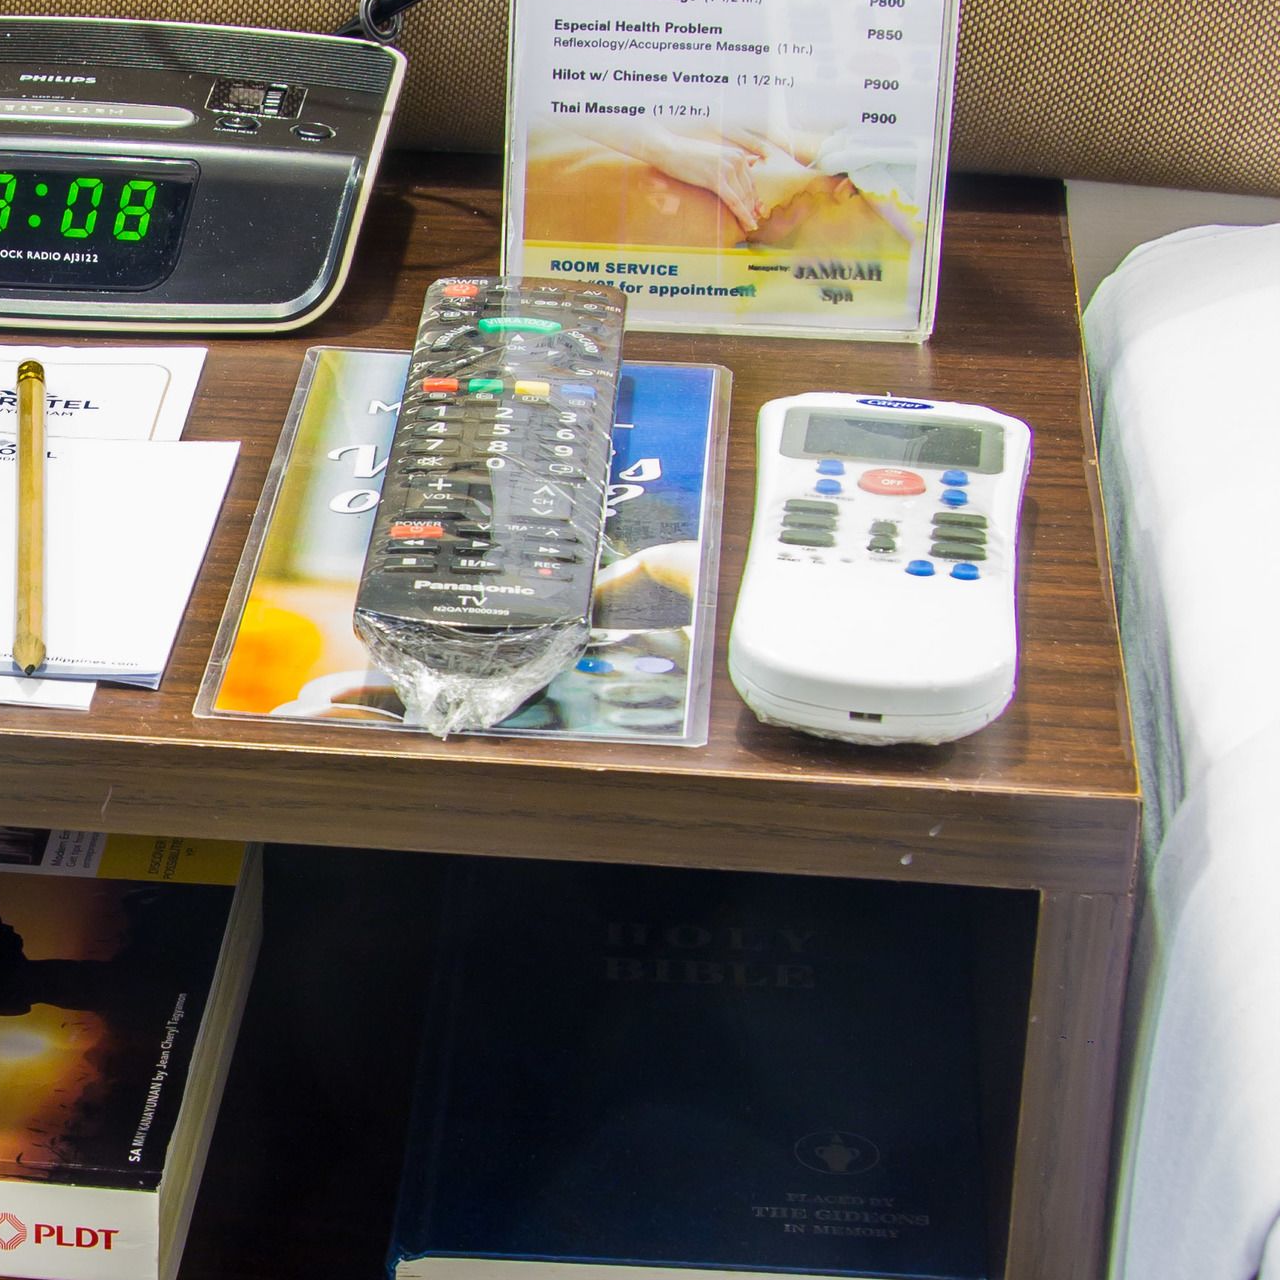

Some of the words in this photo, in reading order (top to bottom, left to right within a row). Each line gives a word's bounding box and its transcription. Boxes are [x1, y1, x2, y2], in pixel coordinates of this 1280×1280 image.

[554, 18, 611, 34] Especial
[615, 20, 660, 33] Health
[664, 21, 723, 35] Problem
[867, 28, 903, 41] P850
[553, 36, 712, 52] Reflexology/Accupressure
[715, 40, 770, 56] Massage
[20, 74, 97, 85] PHILIPS
[552, 68, 586, 81] Hilot
[589, 69, 609, 82] w/
[612, 69, 668, 82] Chinese
[672, 71, 729, 84] Ventoza
[863, 78, 900, 91] P900
[550, 101, 581, 113] Thai
[584, 101, 646, 117] Massage
[861, 112, 897, 125] P900
[26, 250, 62, 262] RADIO
[63, 252, 99, 263] AJ3122
[550, 260, 600, 273] ROOM
[605, 262, 678, 276] SERVICE
[619, 282, 645, 294] for
[648, 283, 756, 298] appointment
[821, 287, 854, 304] Spa
[881, 478, 904, 486] OFF
[532, 498, 554, 506] CH
[395, 520, 442, 528] POWER
[533, 561, 561, 569] REC
[414, 580, 536, 595] Panasonic
[457, 595, 488, 606] TV
[160, 1026, 180, 1050] Cheryl
[155, 1050, 170, 1069] Jean
[151, 1070, 168, 1082] by
[139, 1082, 163, 1132] KANAYUNAN
[131, 1129, 147, 1147] MAY
[128, 1147, 143, 1163] SA
[751, 1206, 808, 1220] THE
[815, 1208, 930, 1226] GIDEONS
[34, 1223, 120, 1250] PLDT
